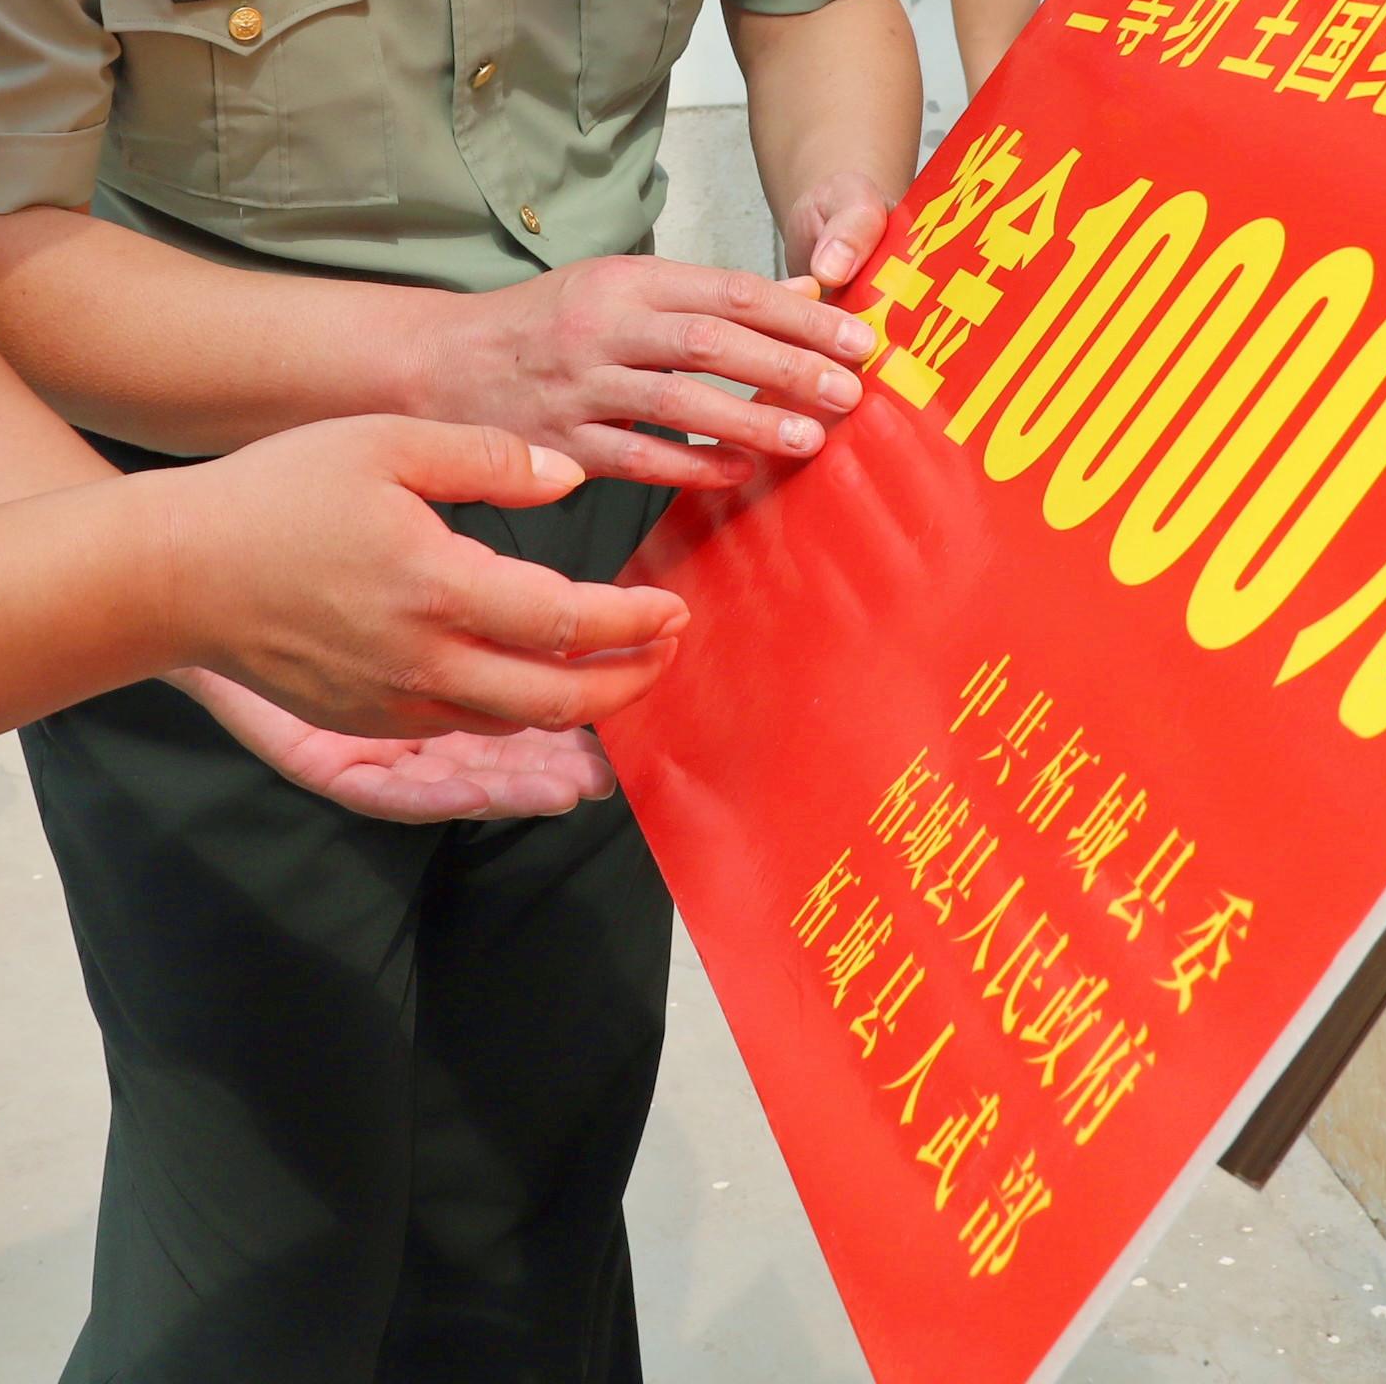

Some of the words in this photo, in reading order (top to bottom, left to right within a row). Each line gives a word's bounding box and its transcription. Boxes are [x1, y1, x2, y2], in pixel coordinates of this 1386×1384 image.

[867, 746, 1156, 1146] 柘城县人民政府
[949, 653, 1254, 1015] 中共柘城县委
[789, 847, 1052, 1278] 柘城县人武部
